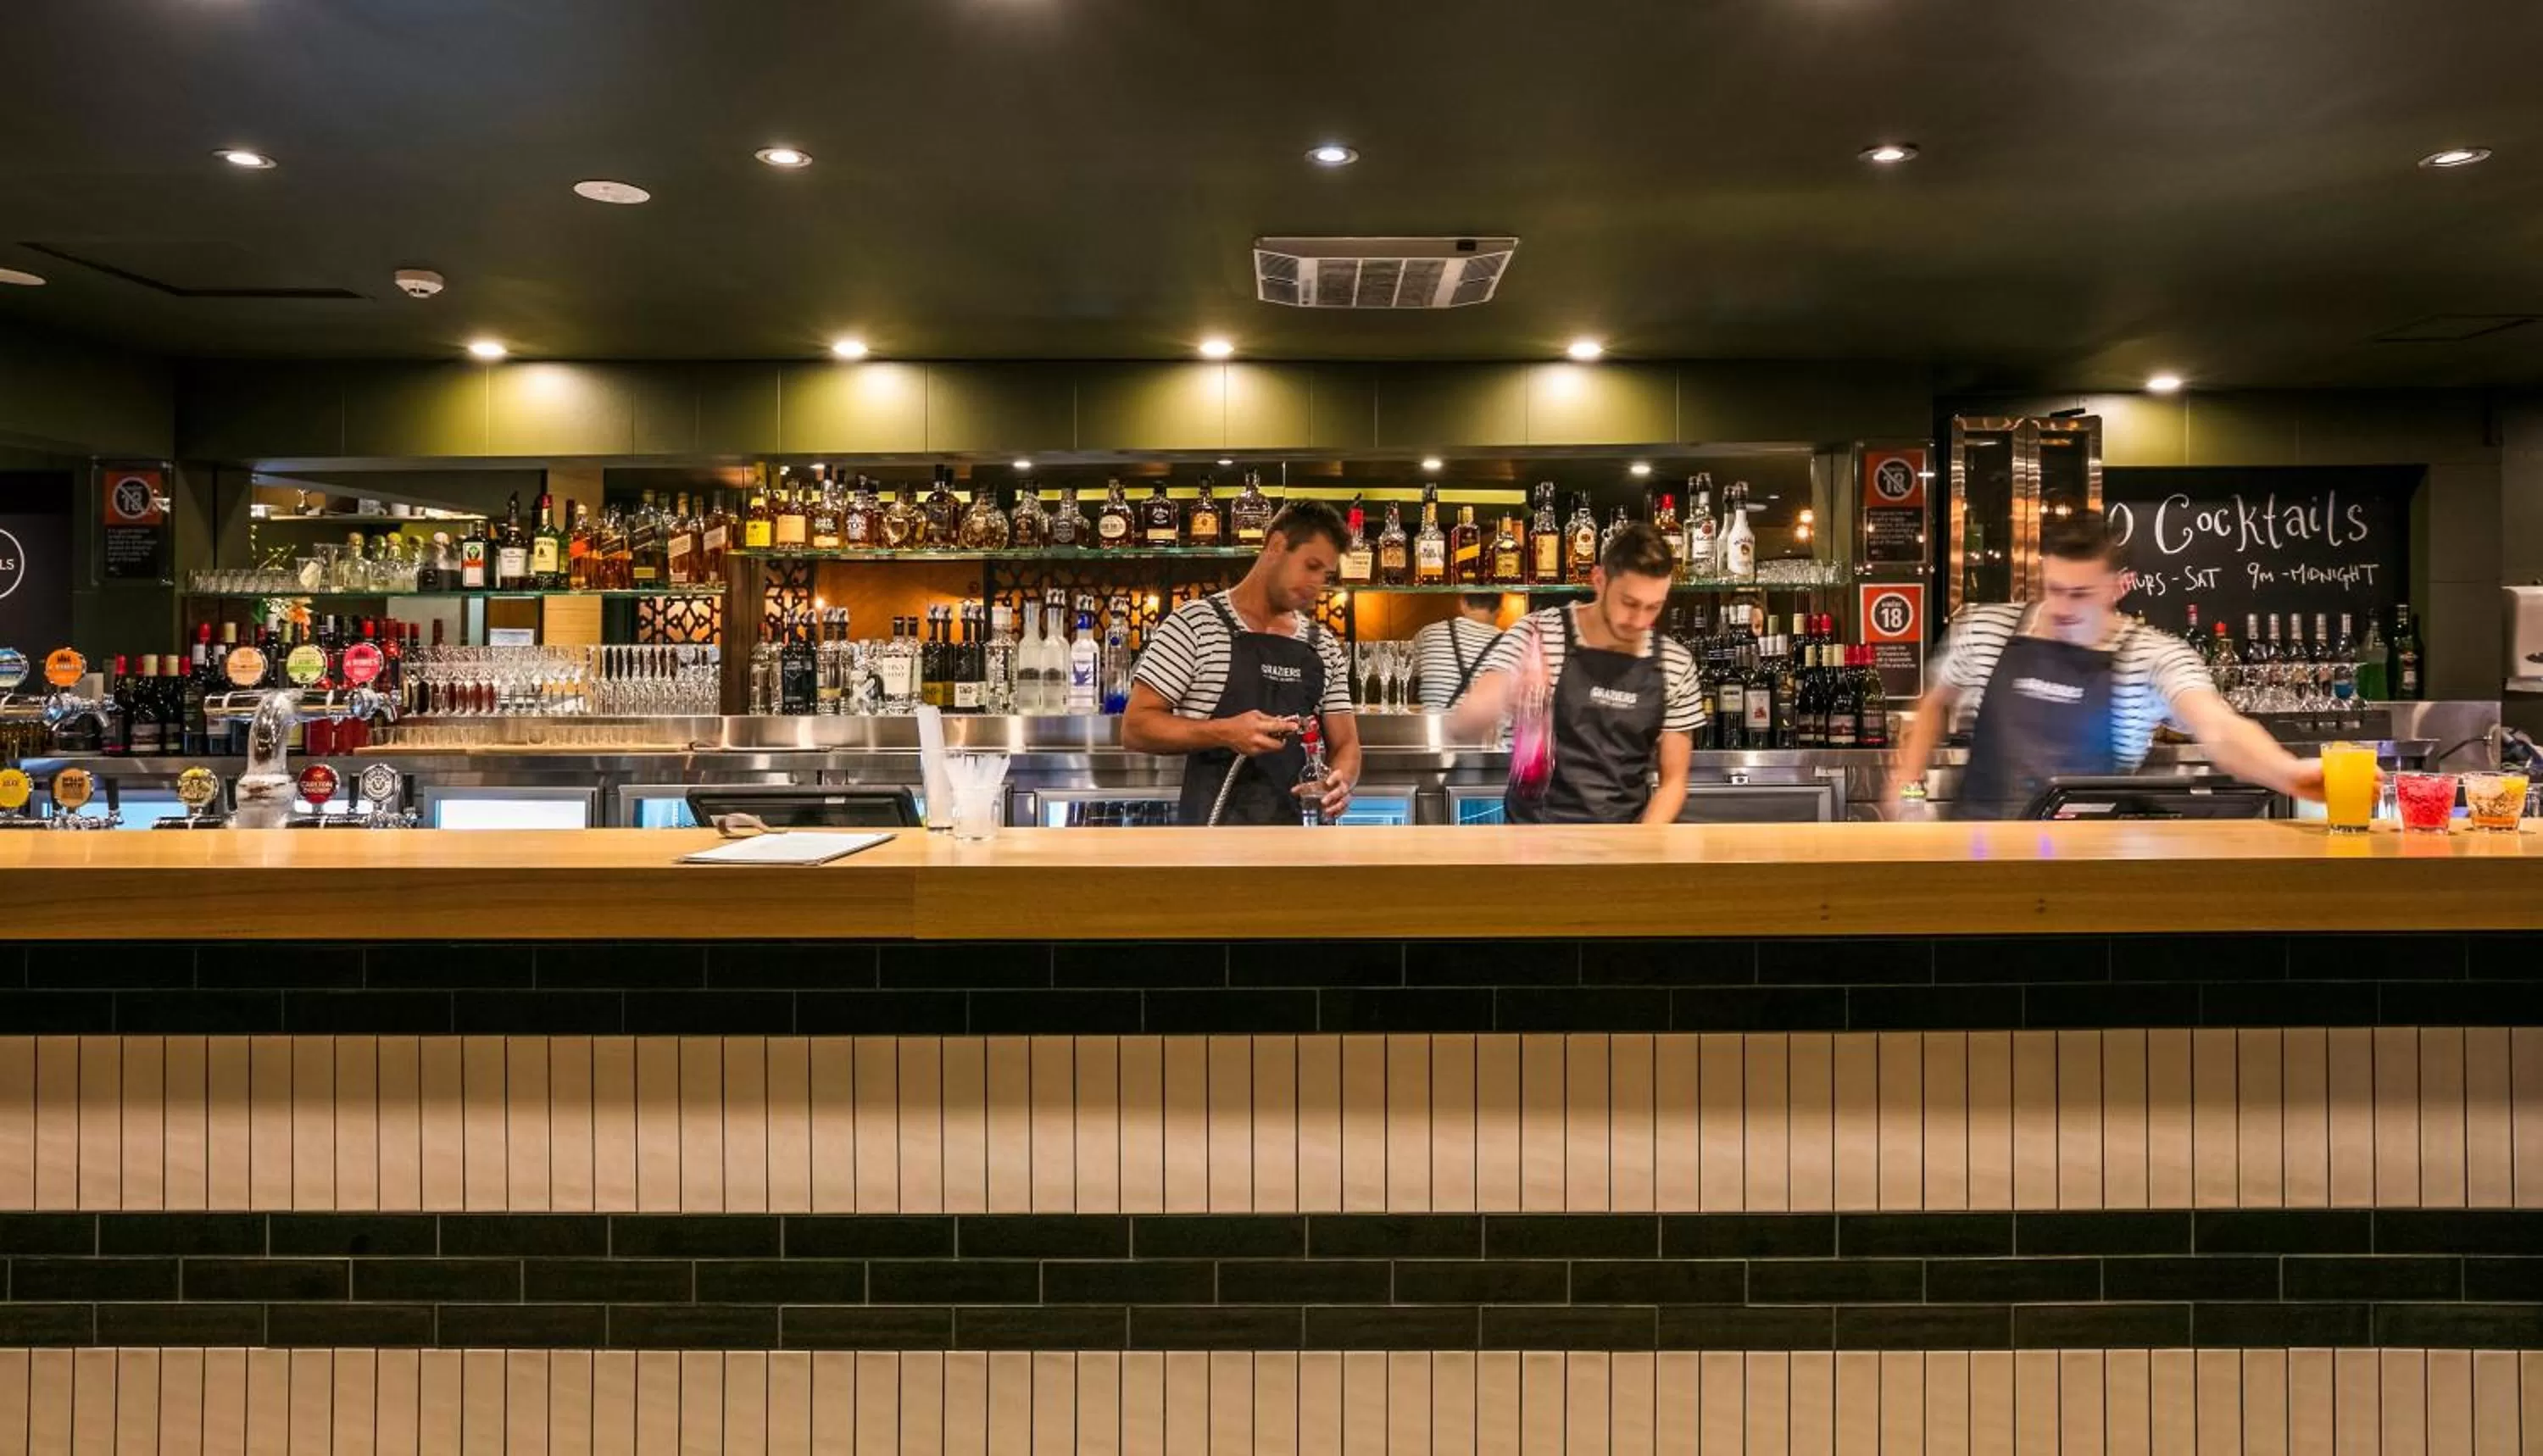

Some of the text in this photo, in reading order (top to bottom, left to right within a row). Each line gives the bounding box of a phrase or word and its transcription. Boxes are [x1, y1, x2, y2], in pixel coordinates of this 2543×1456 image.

[2155, 490, 2368, 554] Cocktails
[2184, 565, 2222, 591] SAT
[1881, 608, 1902, 628] 18
